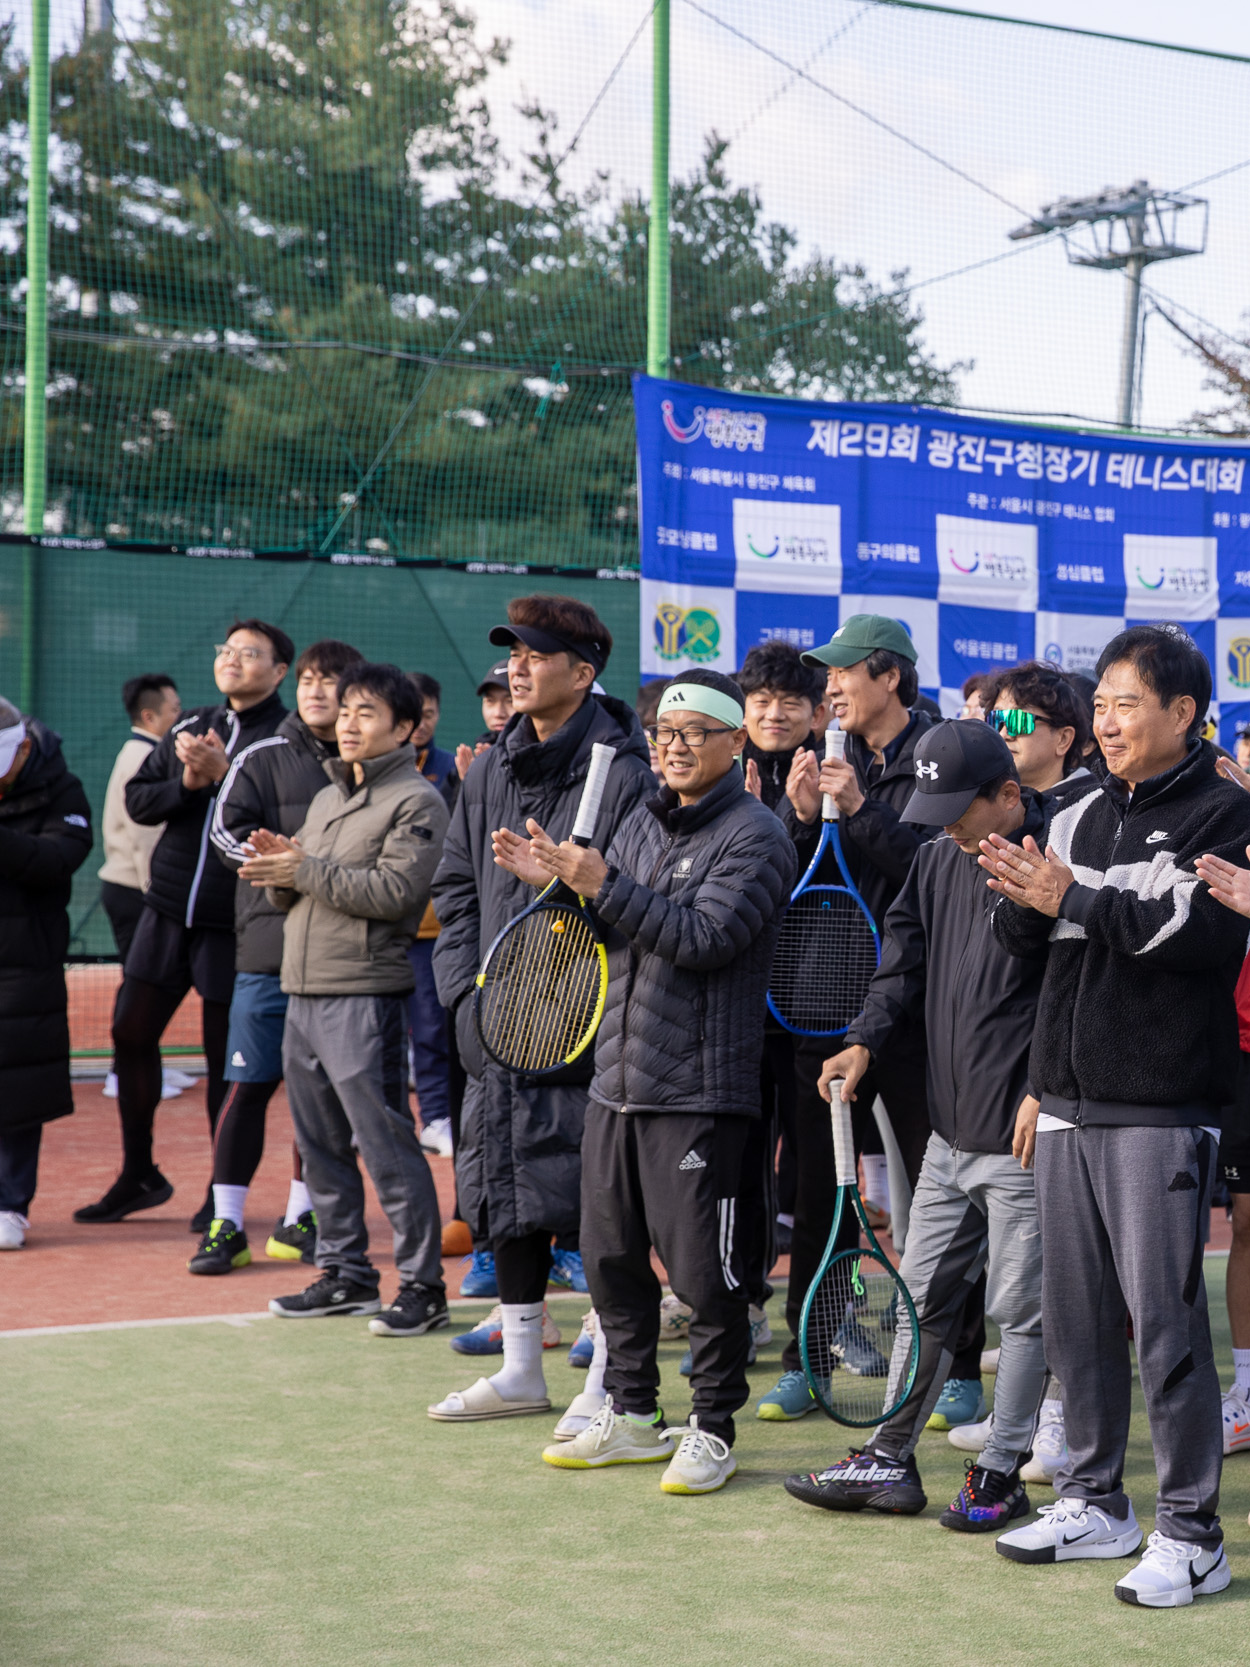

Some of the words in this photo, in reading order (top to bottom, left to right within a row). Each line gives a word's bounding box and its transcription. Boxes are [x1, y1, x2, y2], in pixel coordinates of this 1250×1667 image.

[806, 419, 921, 463] 제29회
[927, 429, 1100, 486] 광진구청장기
[1105, 453, 1246, 494] 테니스대회
[690, 467, 744, 488] 서울특별시
[746, 472, 780, 490] 광진구
[1000, 496, 1033, 515] 서울시
[1063, 503, 1093, 520] 테니스
[678, 1160, 707, 1171] adidas
[818, 1462, 907, 1481] adidas
